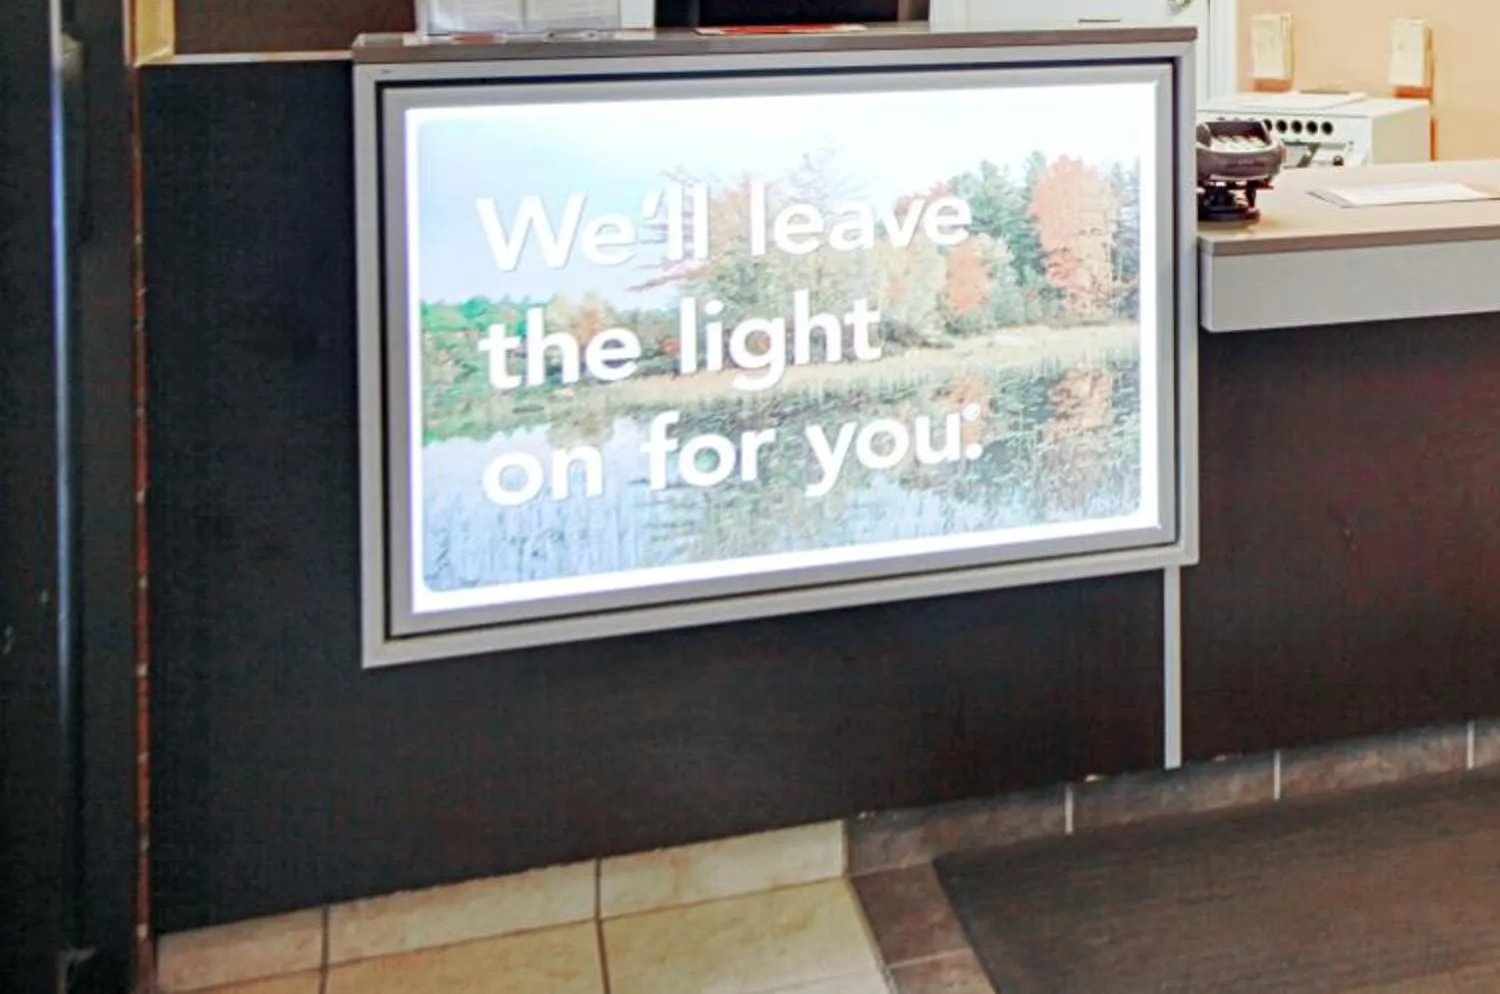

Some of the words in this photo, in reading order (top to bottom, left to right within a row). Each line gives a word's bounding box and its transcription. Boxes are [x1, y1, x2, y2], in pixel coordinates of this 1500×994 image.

[748, 182, 972, 257] leave
[477, 305, 638, 392] the
[679, 289, 884, 392] light
[482, 444, 601, 507] on
[640, 411, 777, 490] for
